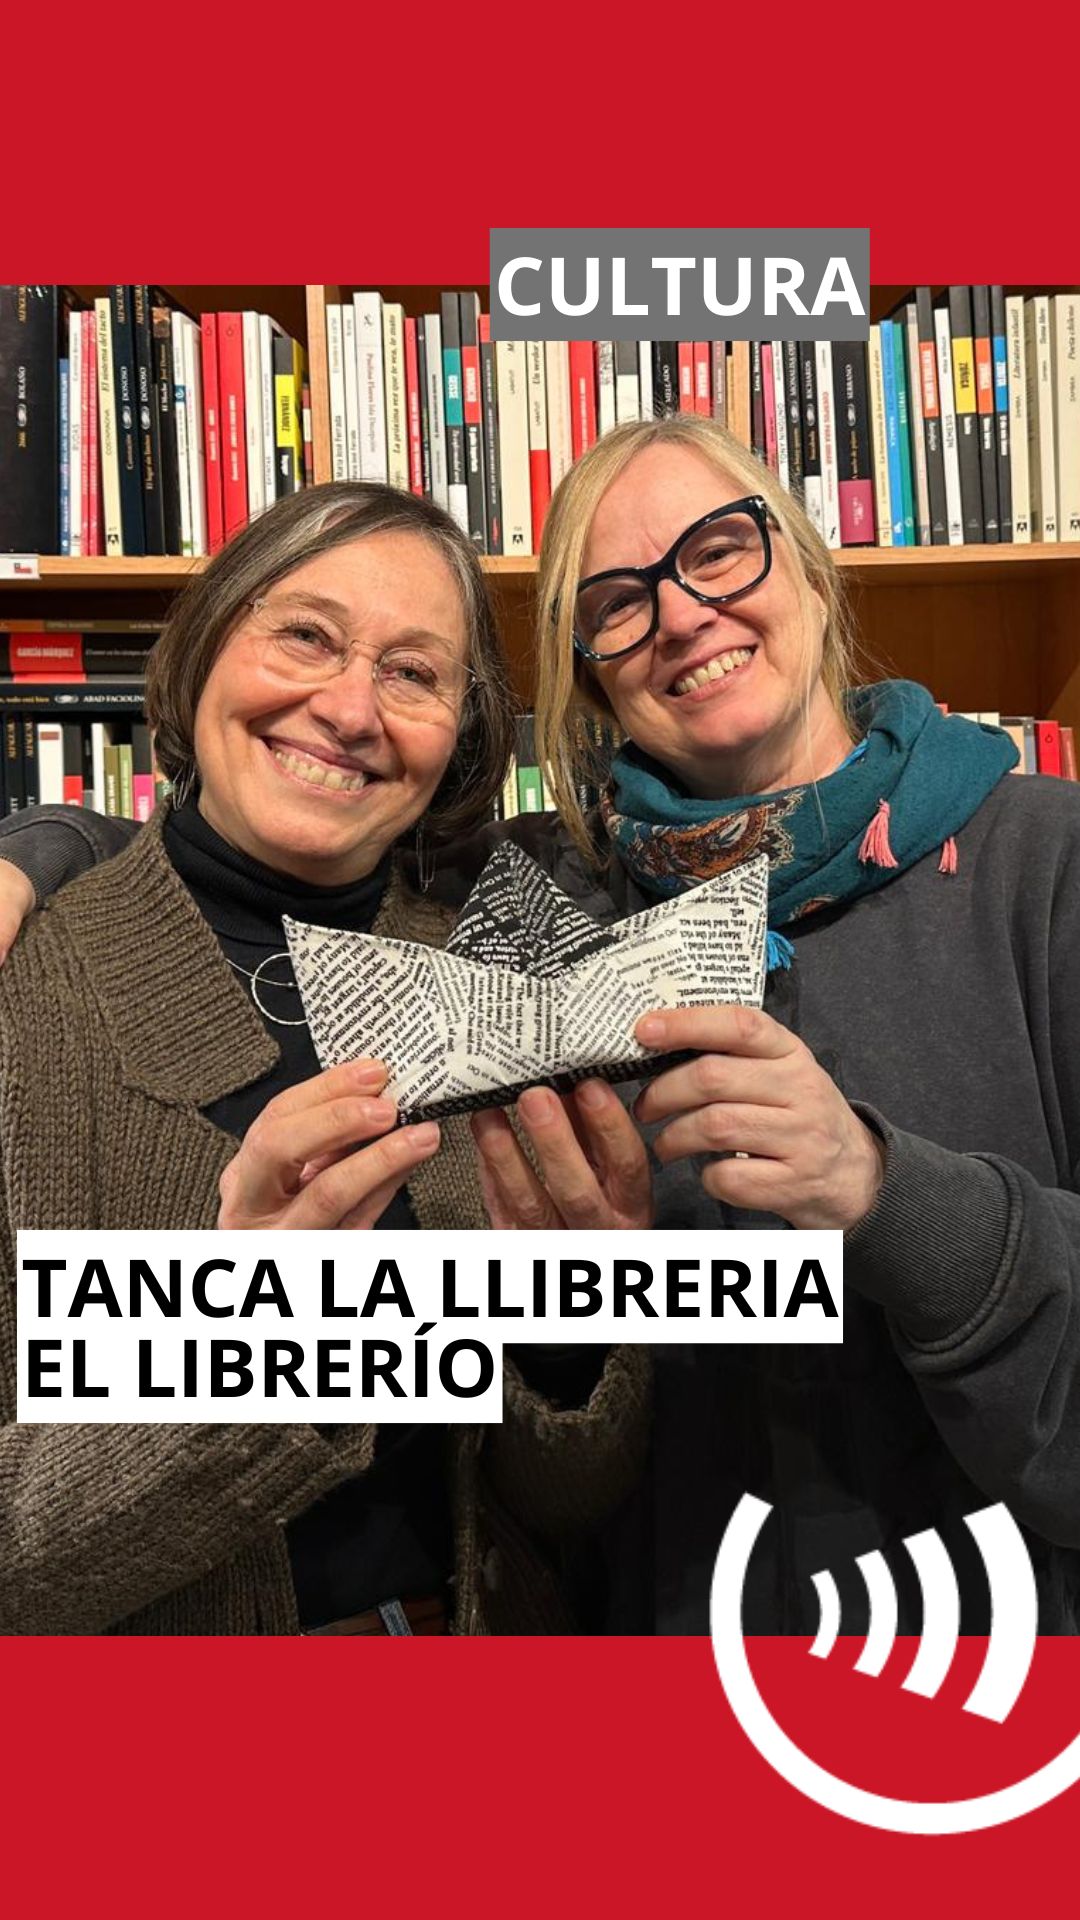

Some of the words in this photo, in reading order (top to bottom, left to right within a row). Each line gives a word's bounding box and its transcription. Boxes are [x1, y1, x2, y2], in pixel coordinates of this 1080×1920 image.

[120, 366, 130, 401] DONOSO
[139, 367, 149, 401] DONOSO
[325, 940, 350, 964] Many
[341, 957, 353, 968] to
[317, 961, 329, 973] of
[324, 964, 344, 984] have
[352, 963, 364, 974] of
[327, 971, 355, 997] houses
[330, 983, 359, 1011] largest
[343, 984, 378, 1017] landslide
[370, 994, 385, 1008] the
[335, 1013, 346, 1024] at
[361, 1002, 392, 1031] growth
[393, 1008, 406, 1020] of
[374, 1016, 397, 1038] these
[340, 1028, 365, 1052] ahead
